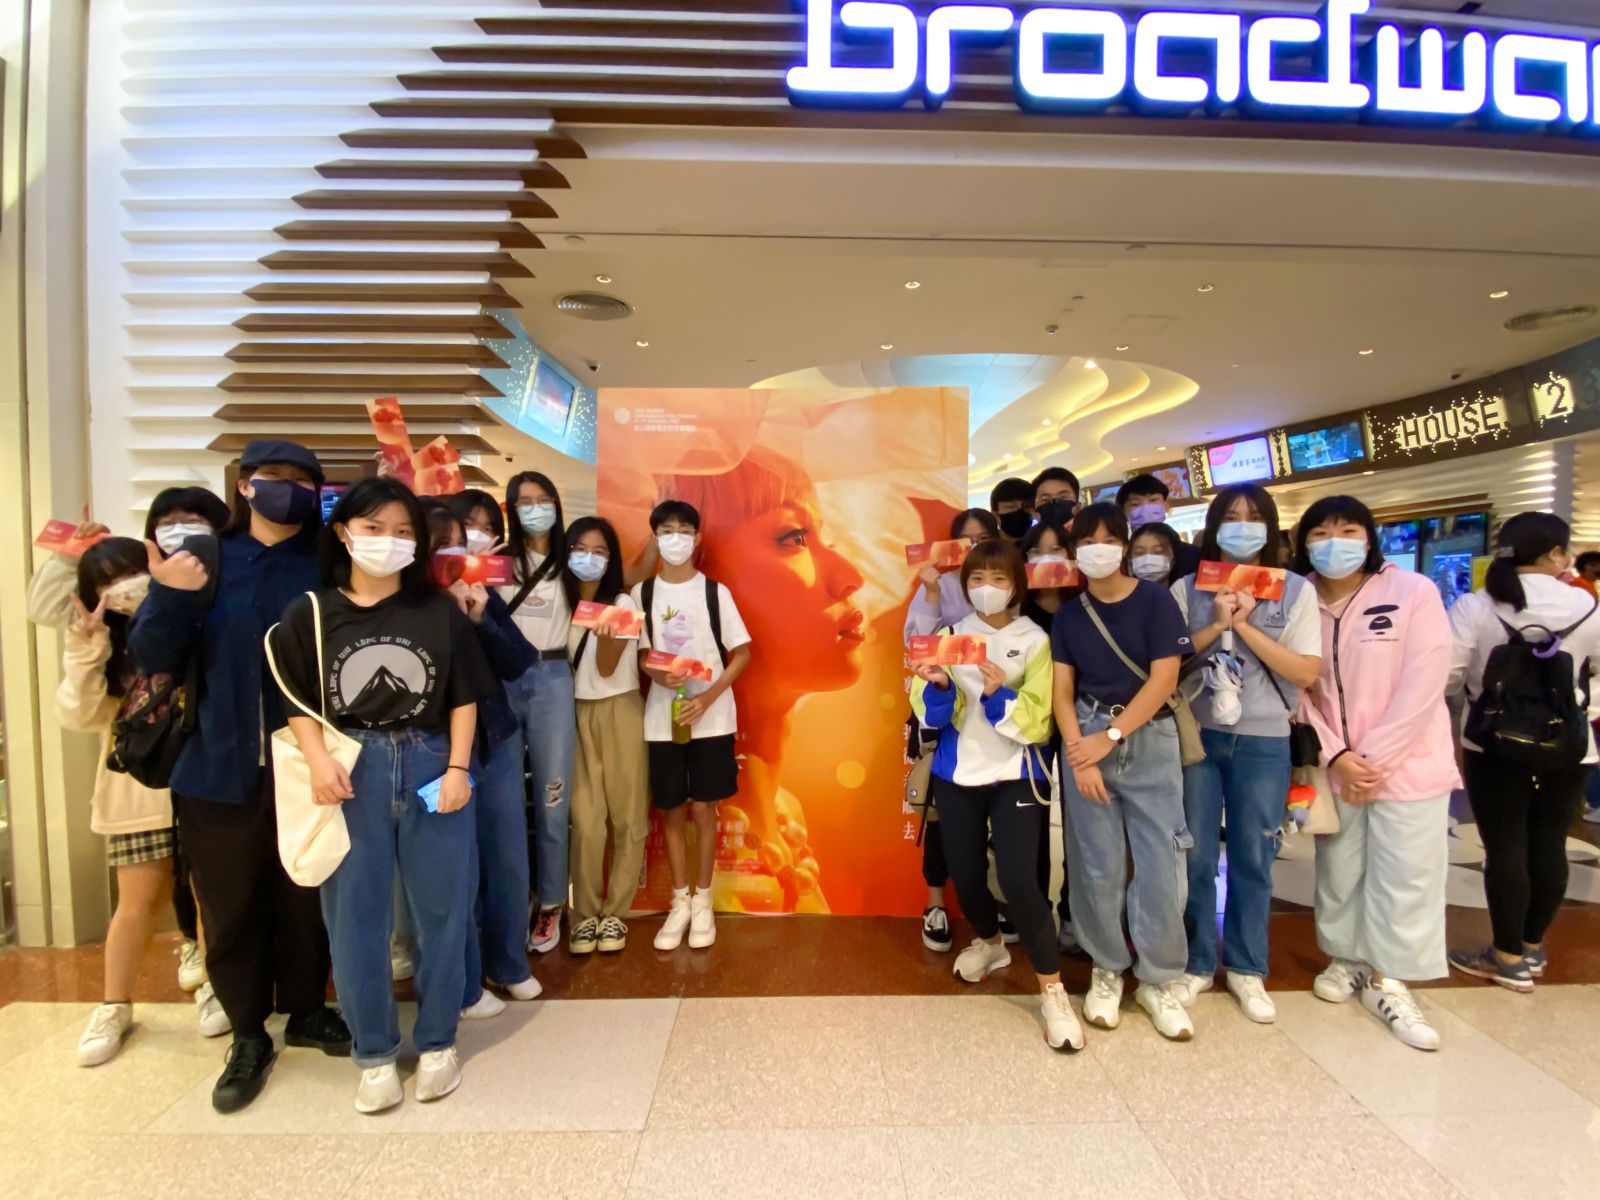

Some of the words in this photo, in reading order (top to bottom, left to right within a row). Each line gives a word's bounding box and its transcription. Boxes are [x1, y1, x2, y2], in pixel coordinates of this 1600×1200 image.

[786, 0, 1600, 123] broadwa
[1401, 399, 1500, 447] HOUSE
[1546, 380, 1568, 416] 2
